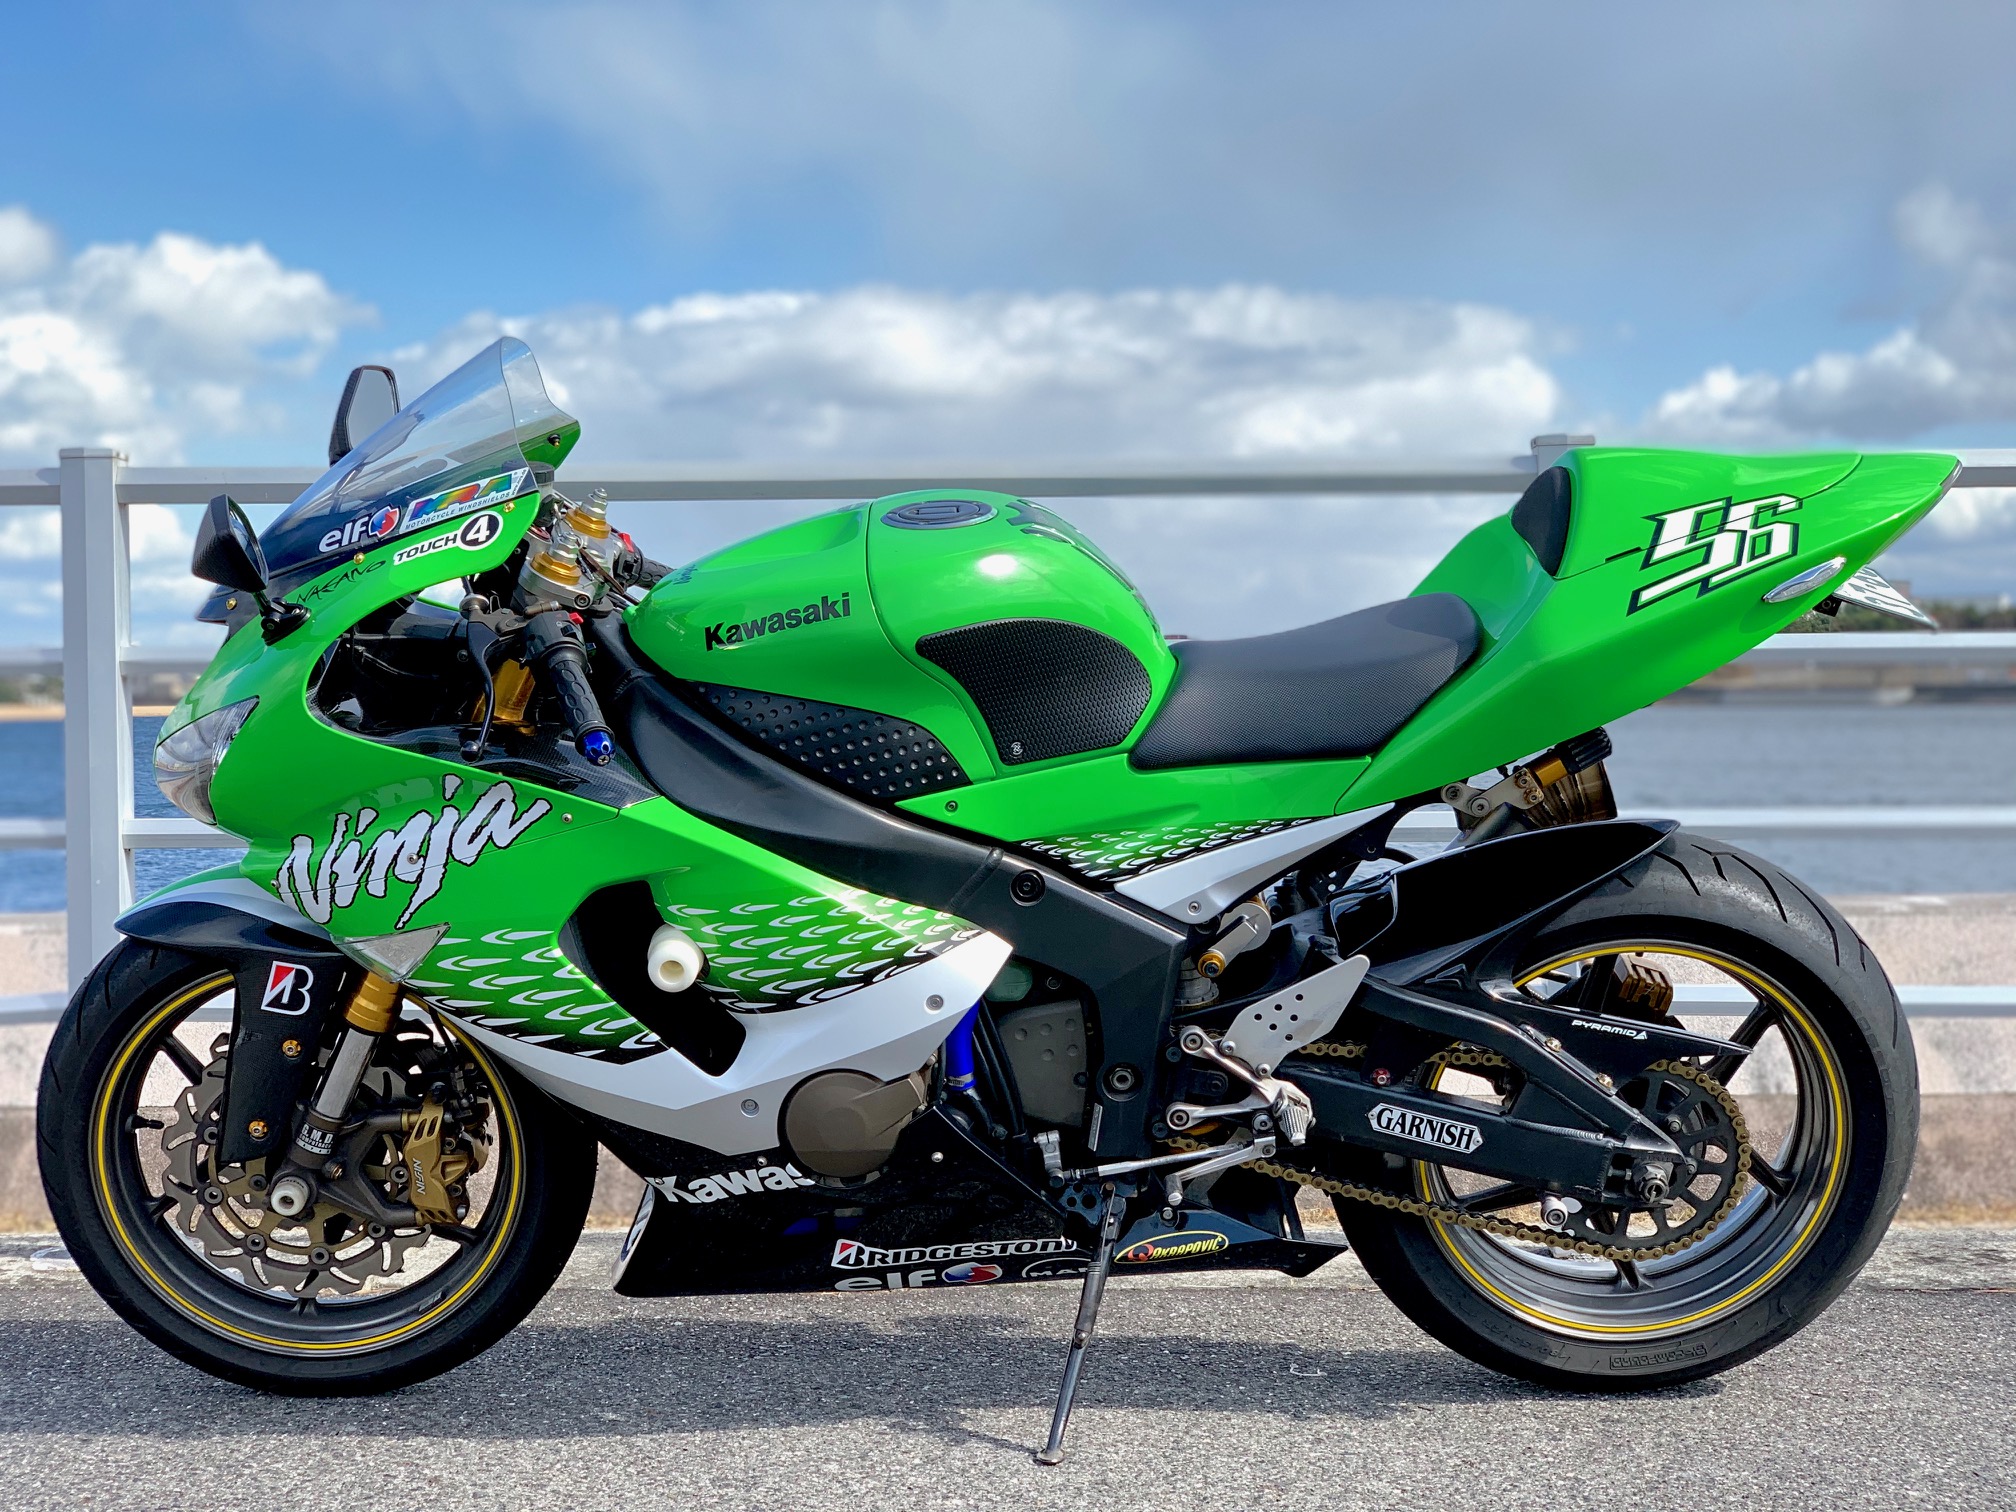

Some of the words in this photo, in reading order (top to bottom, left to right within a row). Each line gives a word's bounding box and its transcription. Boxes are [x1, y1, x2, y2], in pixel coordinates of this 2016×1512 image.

[405, 509, 455, 530] MOTORCYCLE
[458, 491, 511, 512] WINDSHIELDS
[319, 515, 369, 552] elf
[396, 533, 458, 562] TOUCH
[465, 515, 491, 546] 4
[1627, 493, 1803, 616] 56
[704, 592, 852, 650] Kawasaki
[277, 773, 554, 929] Ninja
[1571, 1019, 1637, 1037] PYRAMID
[1376, 1107, 1475, 1150] GARNISH
[834, 1269, 936, 1291] elf
